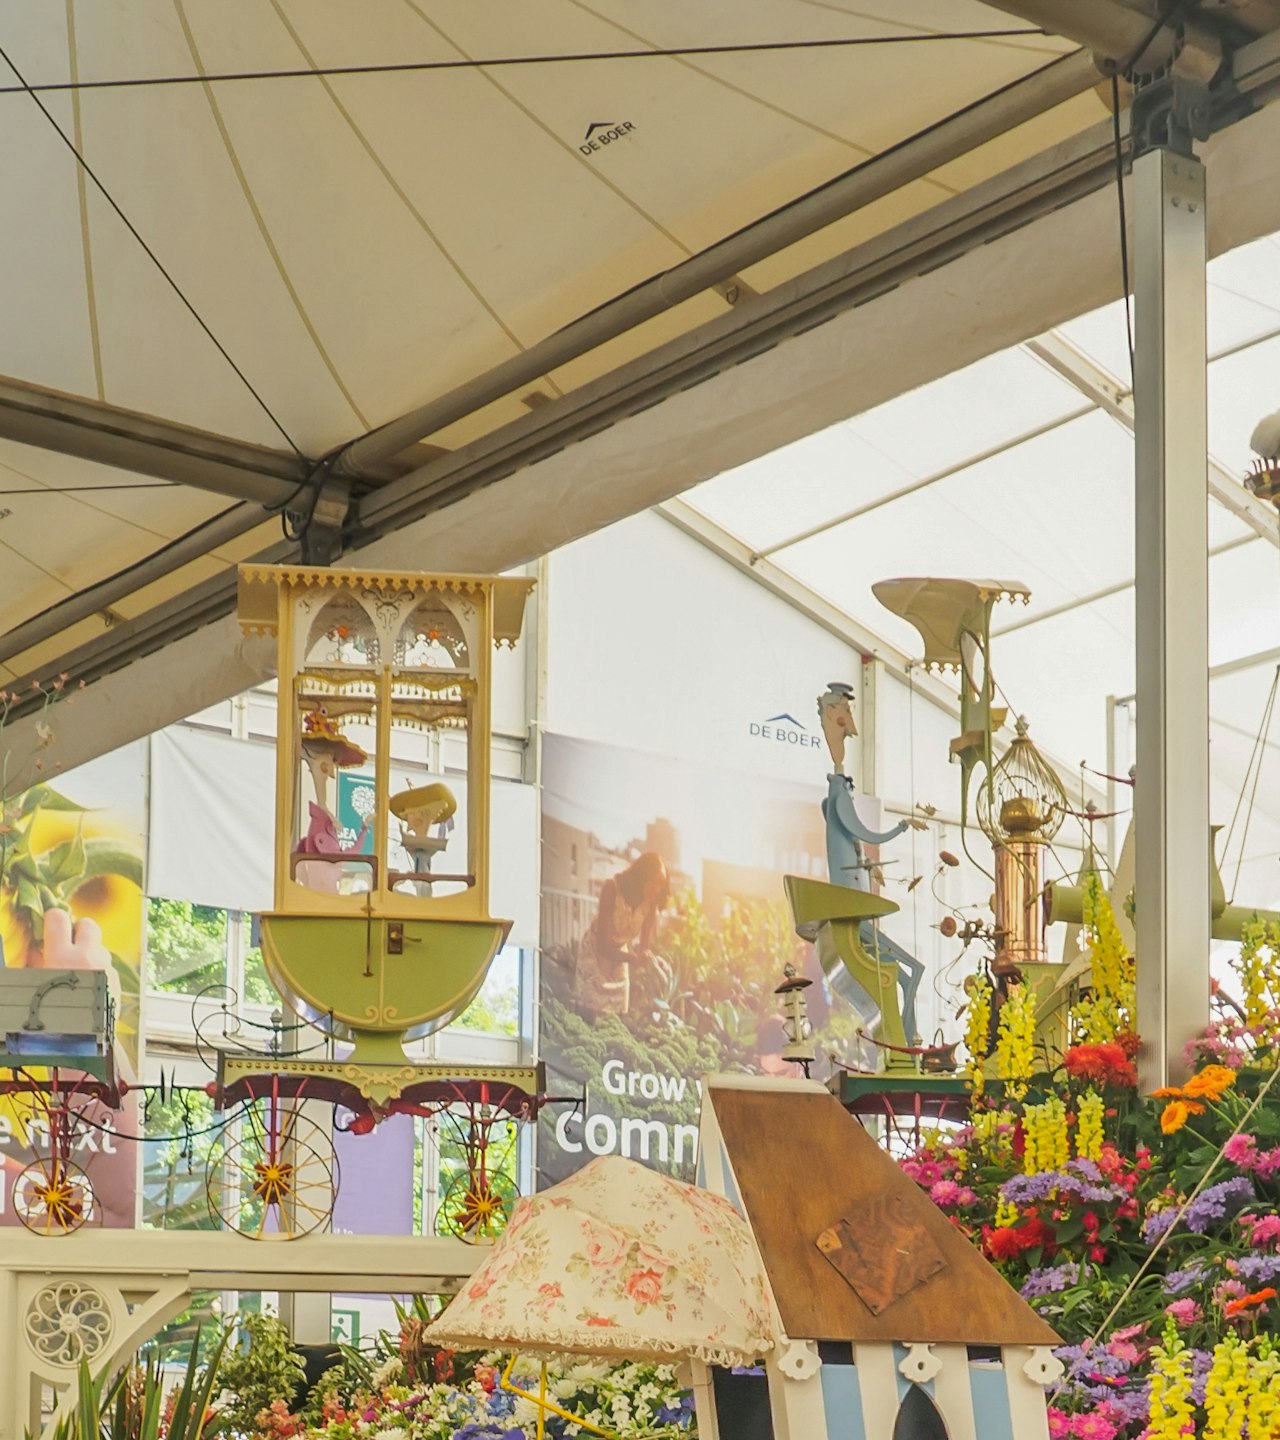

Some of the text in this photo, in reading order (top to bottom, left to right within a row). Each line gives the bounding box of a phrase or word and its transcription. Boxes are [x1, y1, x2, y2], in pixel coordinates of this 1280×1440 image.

[579, 121, 637, 156] DE BOER
[749, 723, 821, 749] DE BOER
[602, 1059, 687, 1102] Grow
[26, 1117, 117, 1154] nxt
